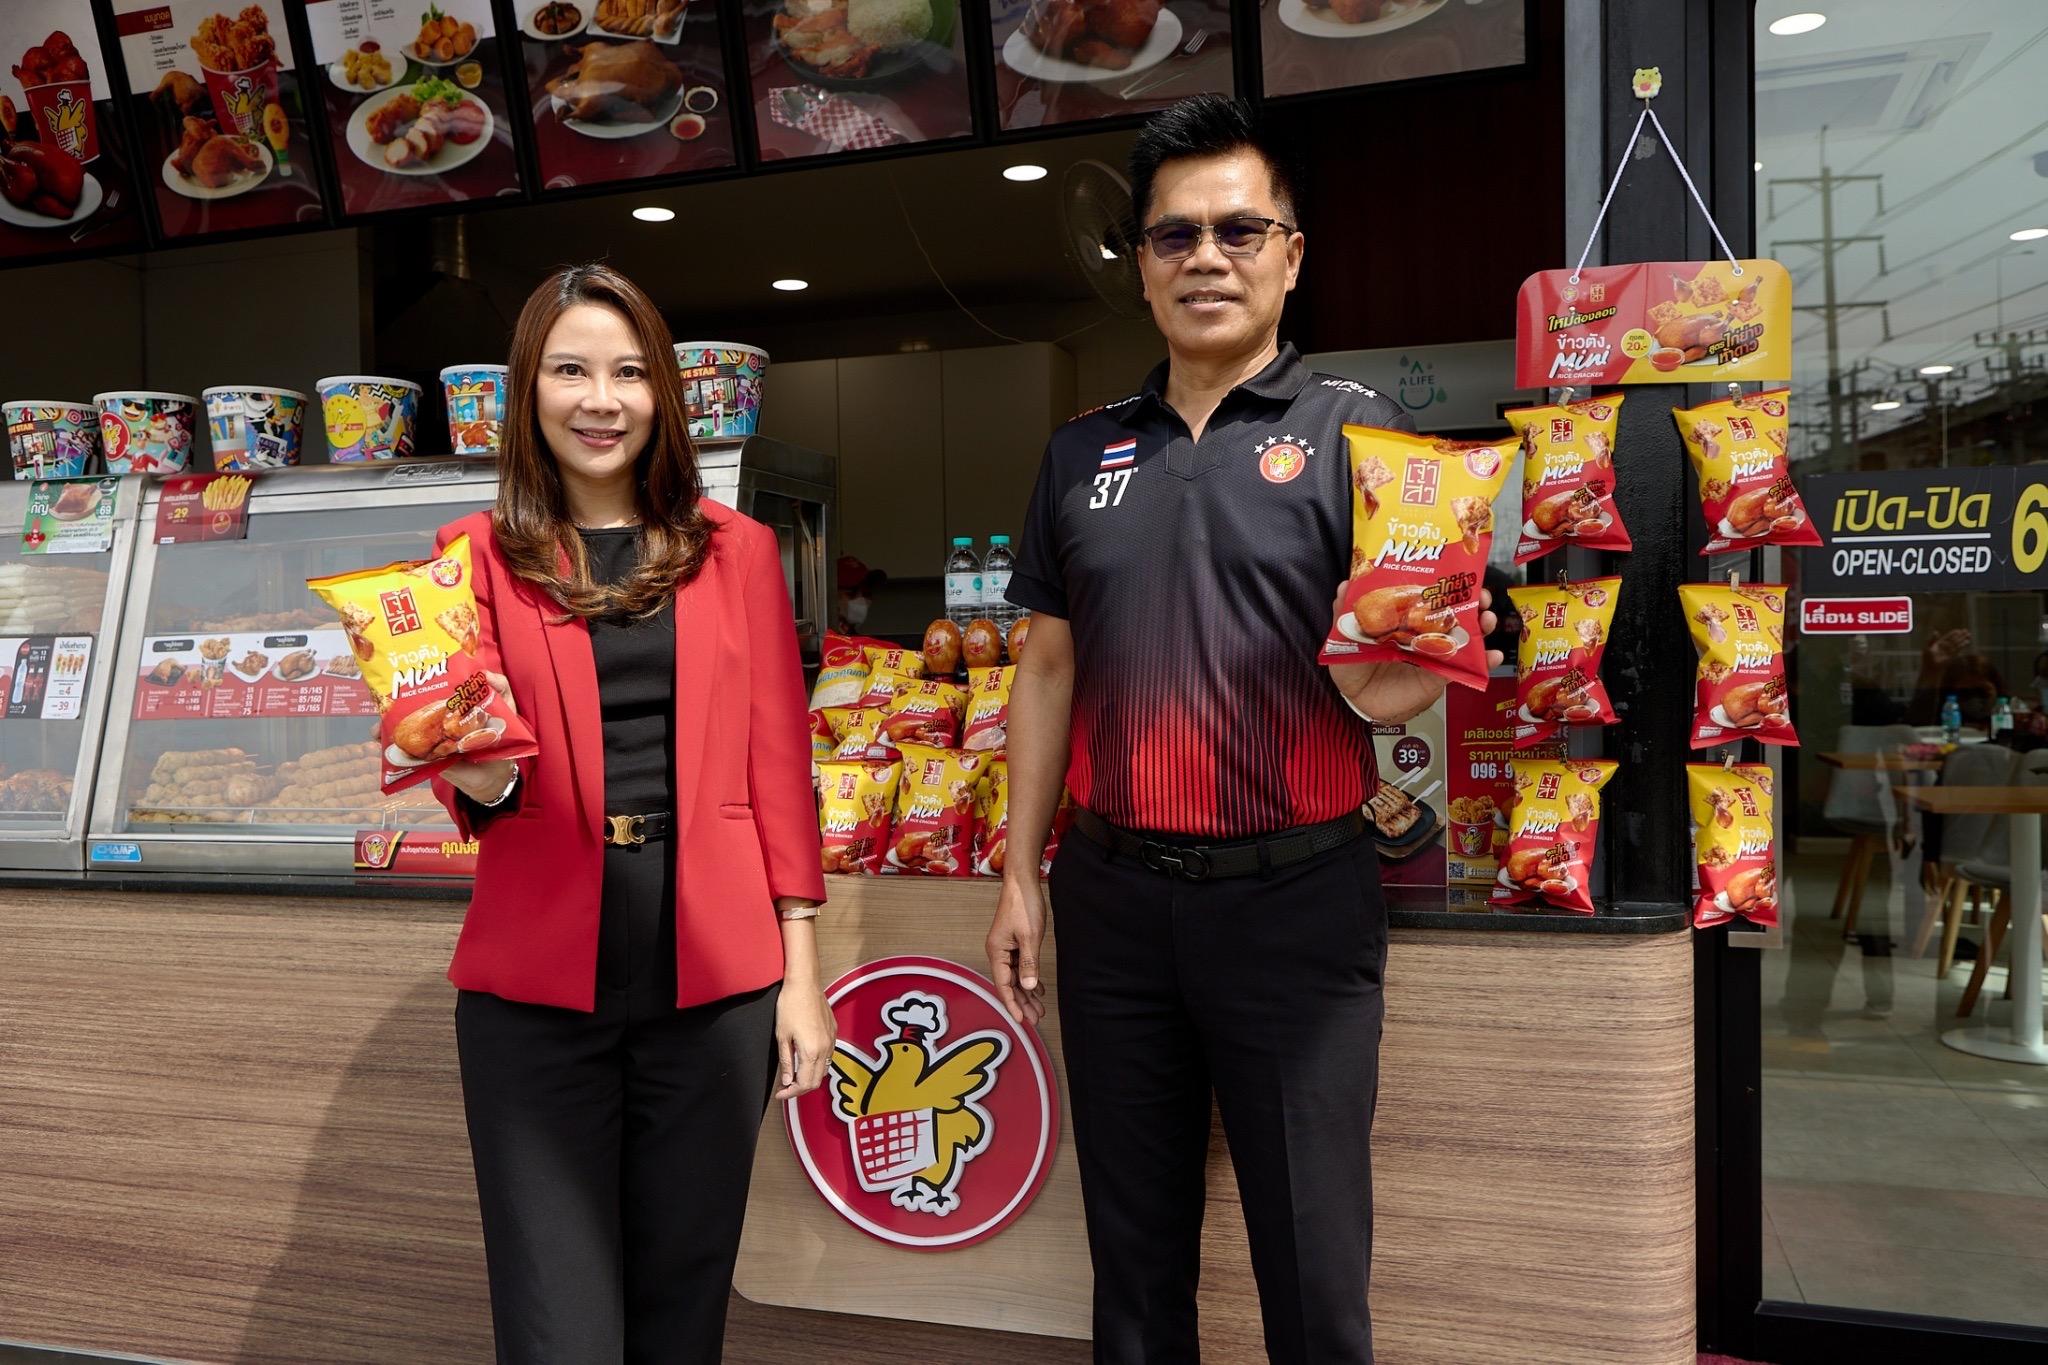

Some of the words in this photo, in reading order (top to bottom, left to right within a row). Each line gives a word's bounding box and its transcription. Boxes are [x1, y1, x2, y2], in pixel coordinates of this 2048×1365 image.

[1557, 333, 1605, 349] ข้าวตัง
[1626, 342, 1648, 351] 20.-
[1708, 340, 1725, 355] สูตร
[1723, 323, 1764, 348] ไก่ย่าง
[1719, 339, 1759, 364] ห้าดาว
[1549, 345, 1611, 379] Mini
[693, 367, 716, 377] STAR
[1399, 378, 1407, 386] A
[1410, 375, 1435, 386] LIFE
[1544, 451, 1580, 465] ข้าวตัง
[1730, 447, 1769, 463] ข้าวตัง
[1406, 459, 1438, 485] เจ้า
[1540, 459, 1585, 486] Mini
[1730, 454, 1775, 485] Mini
[1750, 474, 1773, 482] CRACKER
[100, 506, 111, 515] 69
[174, 507, 189, 519] 29
[1832, 487, 1991, 532] เปิด-ปิด
[1387, 517, 1441, 541] ข้าวตัง
[1374, 538, 1447, 567] Mini
[1383, 563, 1401, 571] RICE
[1401, 564, 1434, 574] CRACKER
[1832, 546, 1992, 577] OPEN-CLOSED
[1454, 601, 1480, 613] CHICKEN
[1805, 604, 1854, 624] เลื่อน
[1857, 611, 1909, 624] SLIDE
[1536, 637, 1569, 650] ข้าวตัง
[1734, 641, 1769, 653] ข้าวตัง
[387, 643, 440, 669] ข้าวตัง
[1532, 646, 1573, 671] Mini
[1733, 649, 1773, 673] Mini
[391, 651, 449, 699] Mini
[401, 688, 418, 698] RICE
[418, 681, 449, 694] CRACKER
[58, 702, 69, 711] 39
[906, 803, 944, 821] Mini
[1526, 806, 1558, 820] ข้าวตัง
[823, 818, 860, 835] Mini
[1518, 818, 1562, 837] Mini
[1739, 826, 1767, 839] ข้าวตัง
[97, 845, 136, 855] CHAMP
[1736, 836, 1772, 860] Mini
